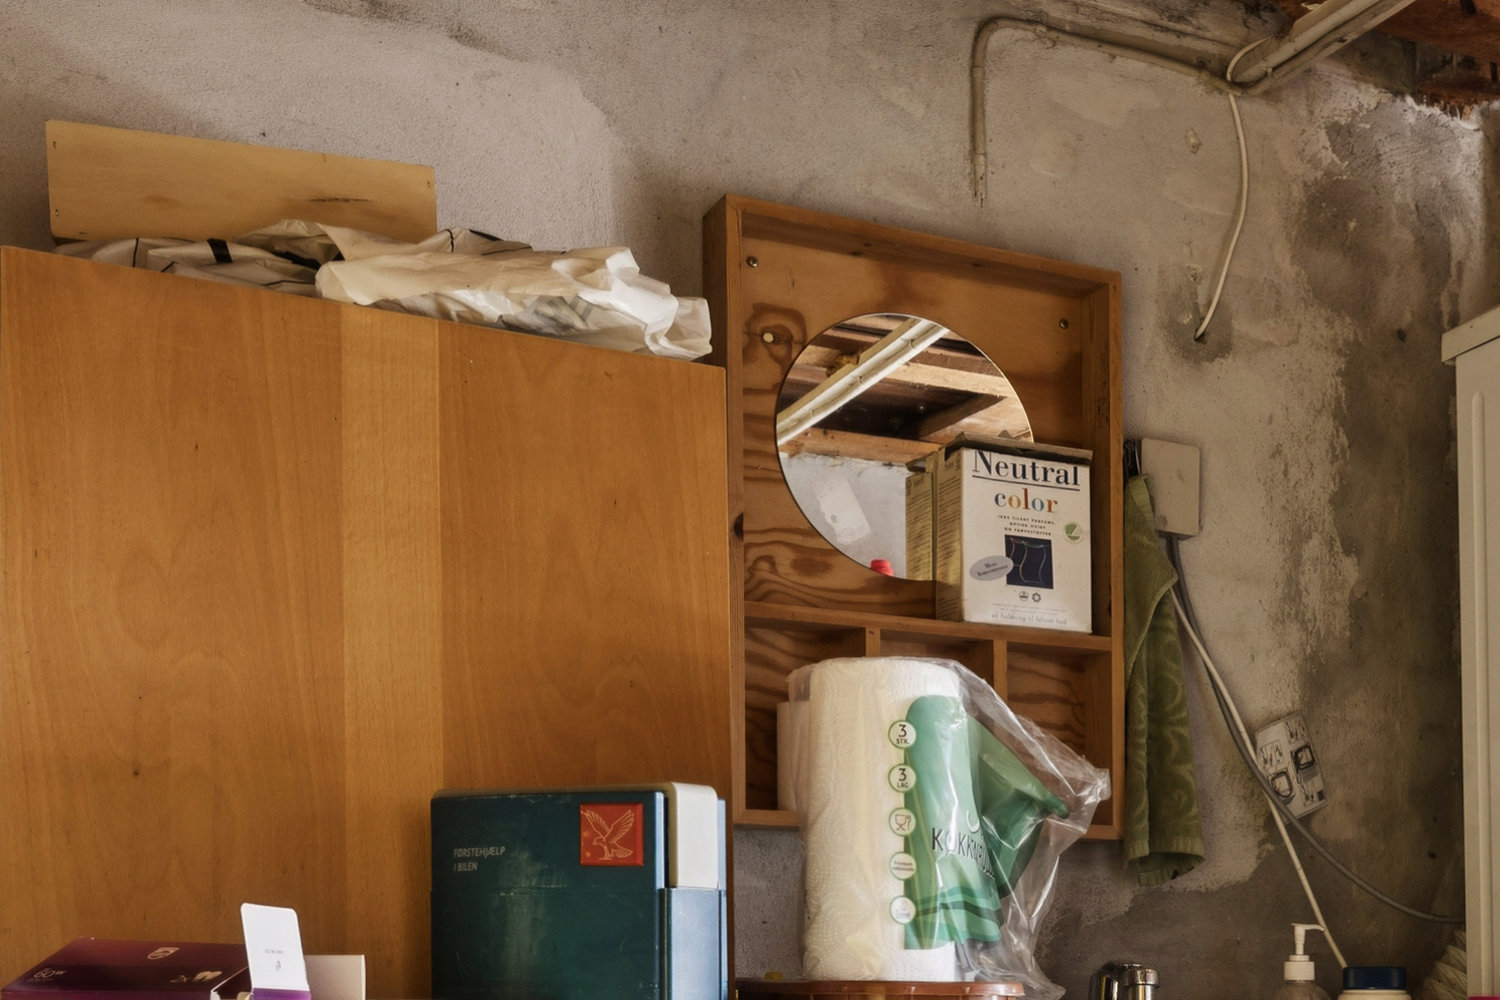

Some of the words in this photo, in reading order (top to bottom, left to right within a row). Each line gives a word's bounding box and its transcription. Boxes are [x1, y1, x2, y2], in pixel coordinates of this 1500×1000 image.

[972, 450, 1081, 487] Neutral
[994, 487, 1059, 514] color
[898, 724, 907, 738] 3
[898, 768, 907, 782] 3
[896, 781, 910, 789] LAG
